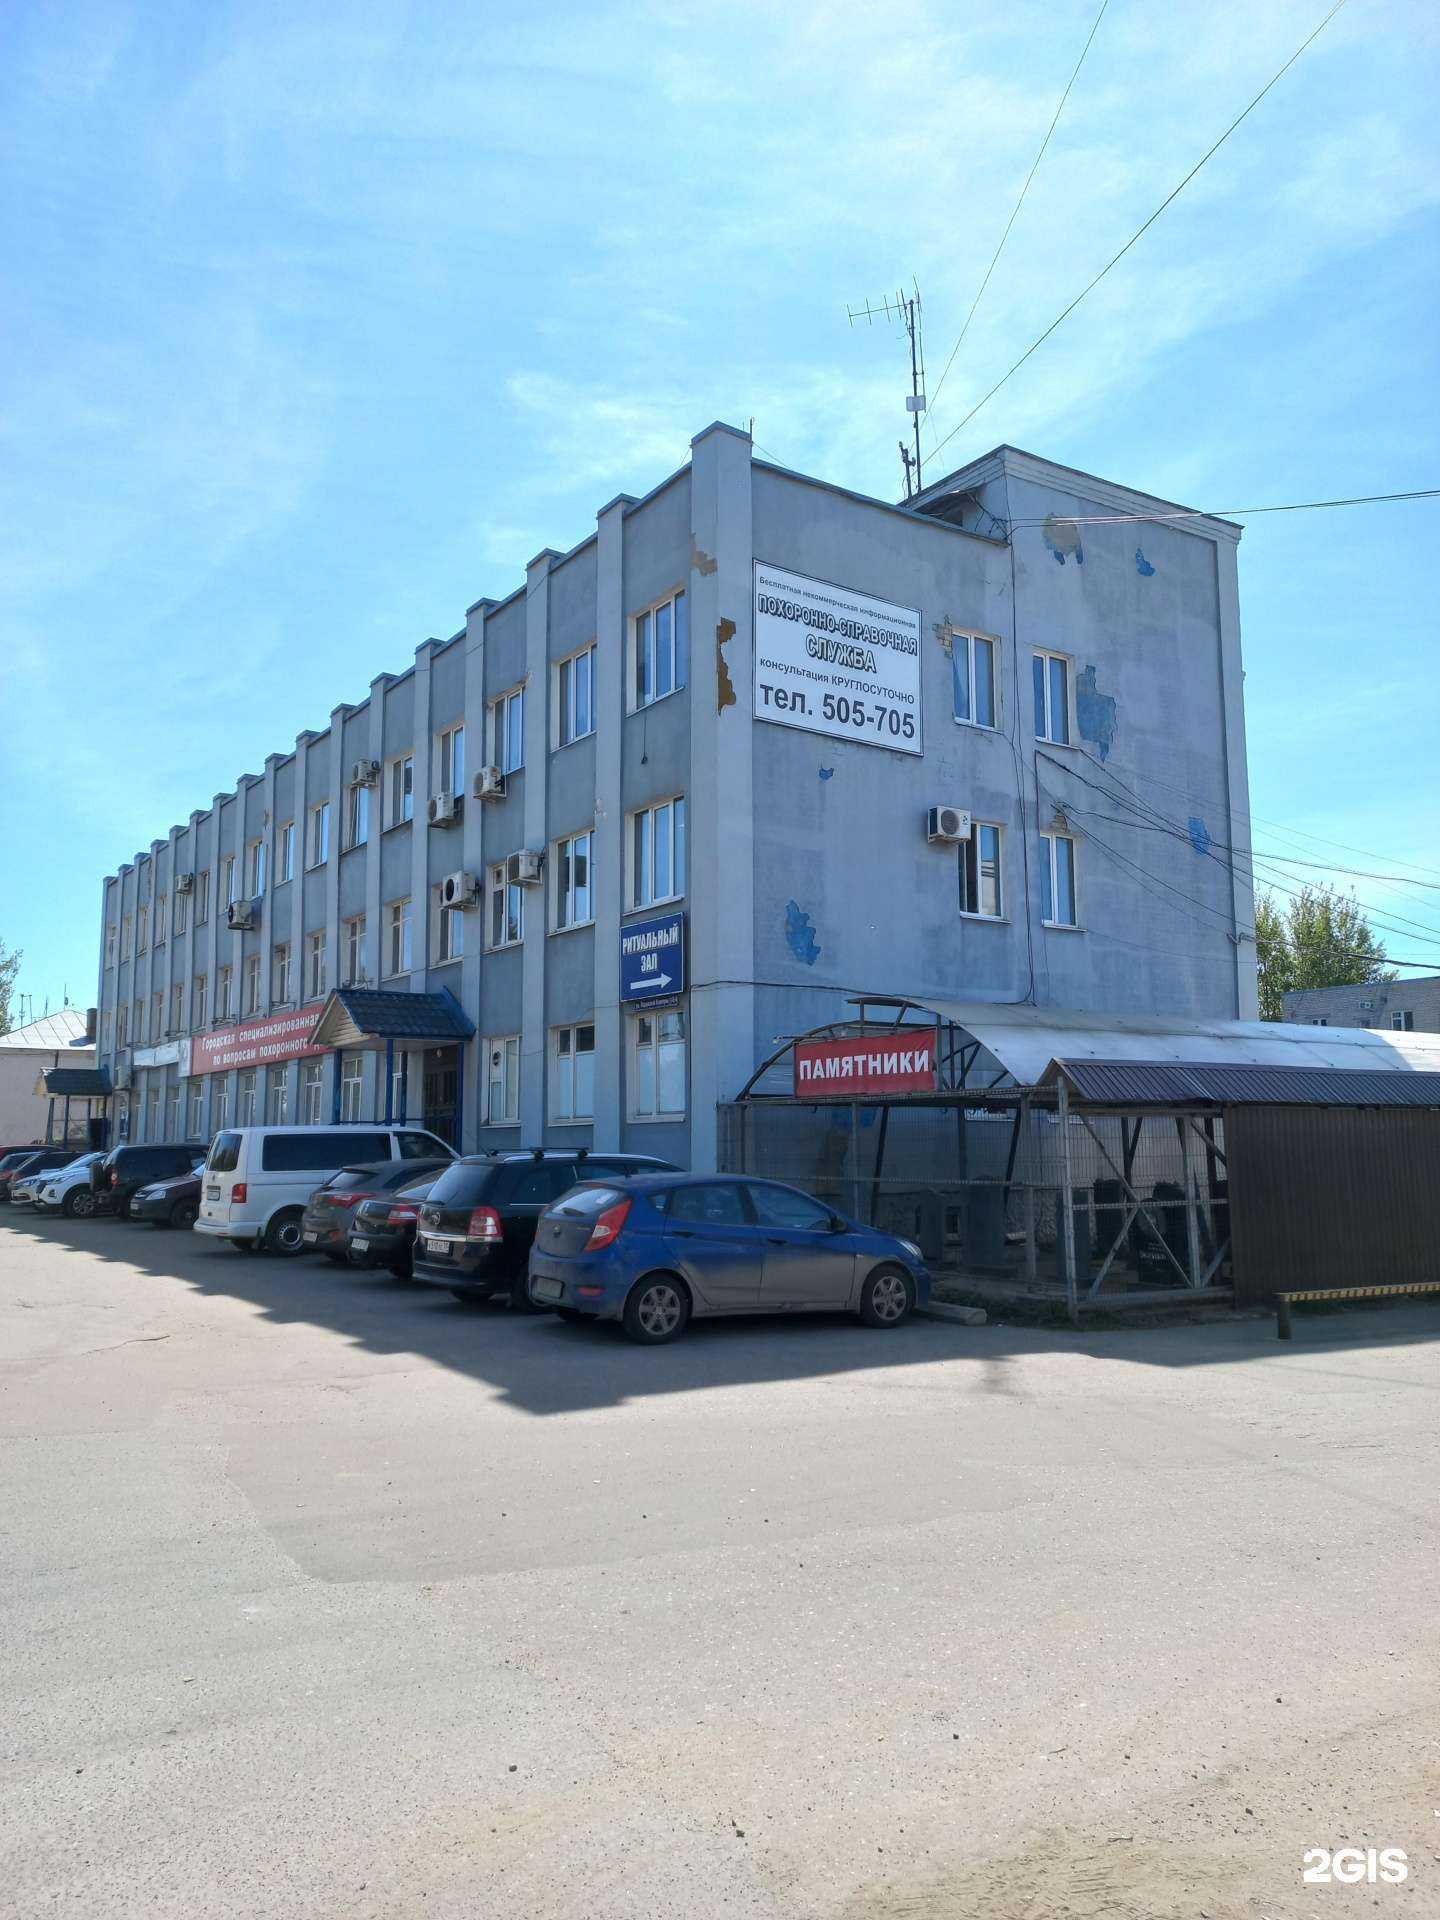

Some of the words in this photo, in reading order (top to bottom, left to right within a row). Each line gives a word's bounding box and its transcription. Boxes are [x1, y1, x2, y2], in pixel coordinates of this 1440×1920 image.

[759, 576, 801, 595] Бесплатная
[758, 593, 918, 656] ПОХОРОННО-СПРАВОЧНАЯ
[805, 633, 877, 673] СЛУЖБА
[760, 657, 829, 684] консультация
[832, 675, 915, 705] КРУГЛОСУТОЧНО
[760, 684, 813, 716] тел.
[822, 692, 915, 739] 505-705
[622, 922, 679, 955] РИТУАЛЬНЫЙ
[640, 953, 658, 972] ЗАЛ
[202, 1034, 235, 1051] Городская
[239, 1013, 320, 1042] специализированная
[213, 1054, 221, 1066] по
[223, 1049, 256, 1066] вопросам
[259, 1037, 308, 1058] похоронного
[800, 1050, 929, 1081] ПАМЯТНИКИ
